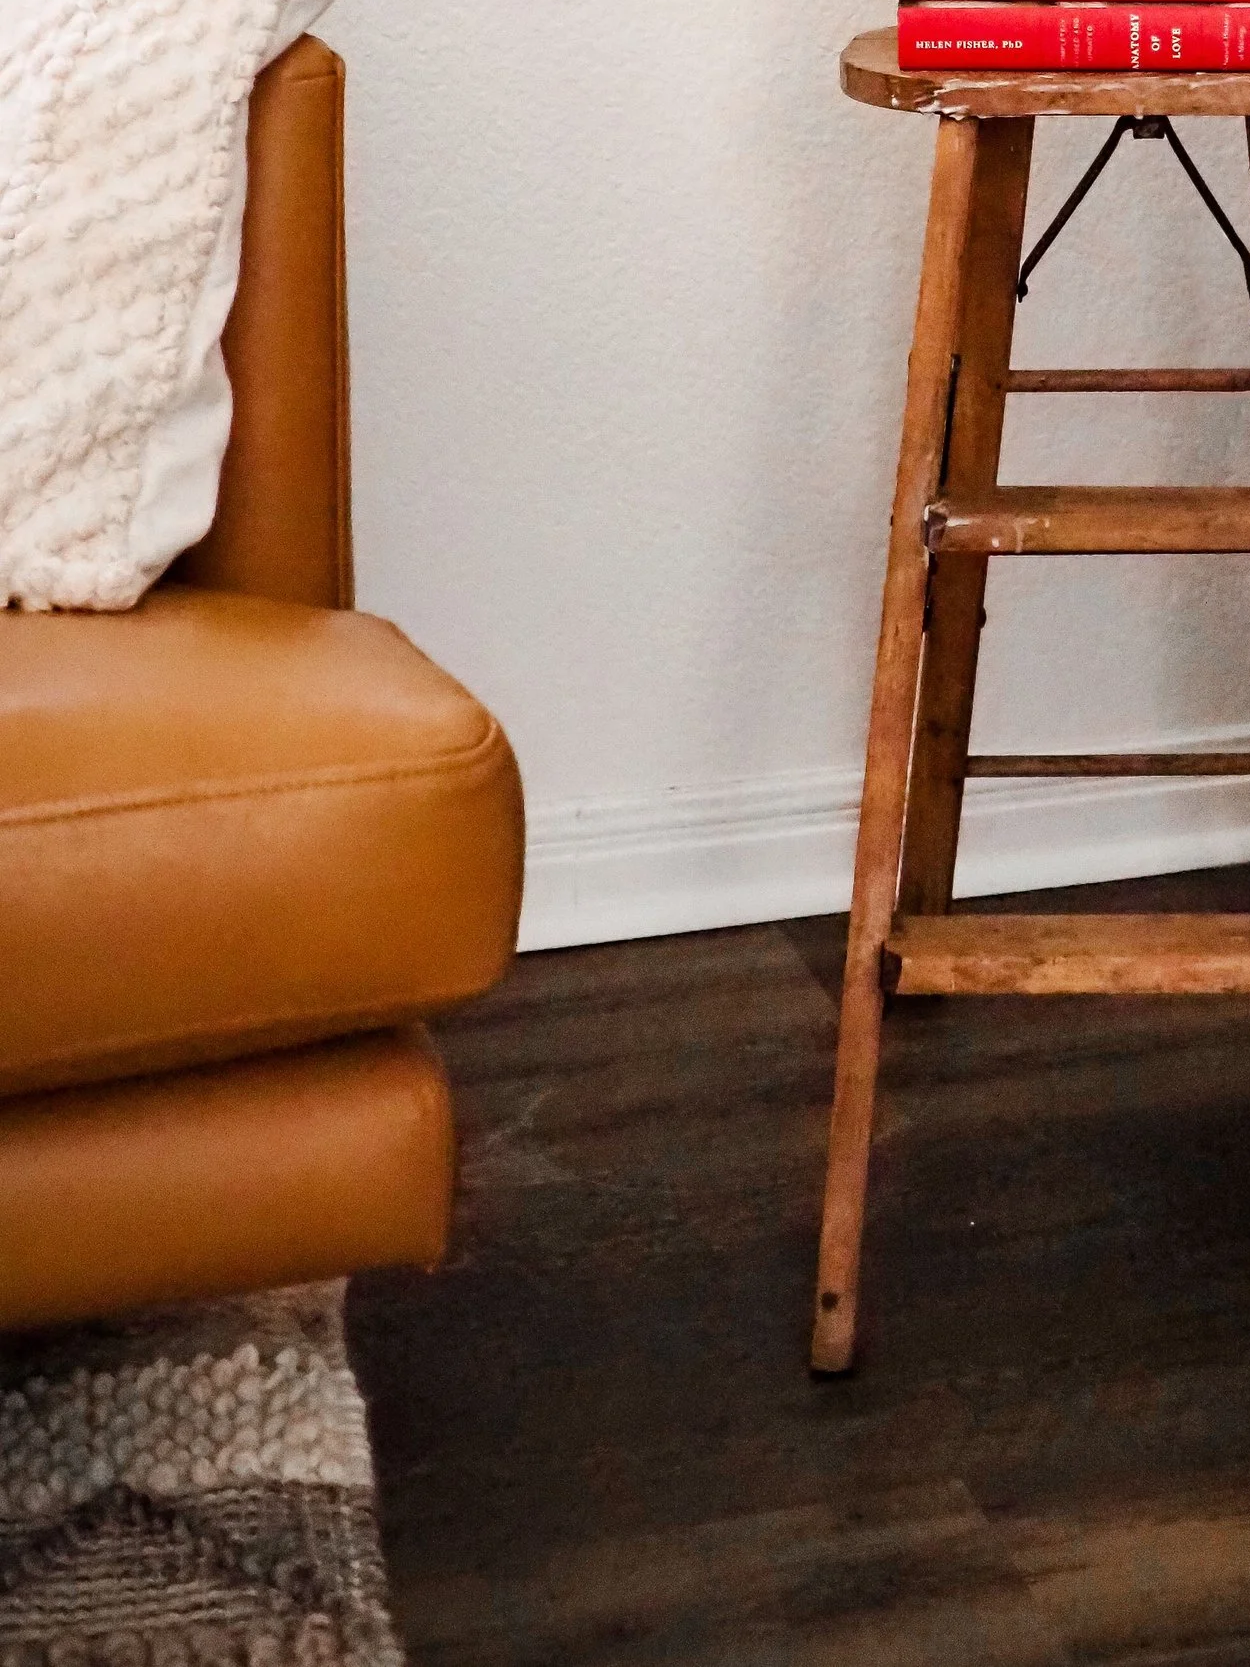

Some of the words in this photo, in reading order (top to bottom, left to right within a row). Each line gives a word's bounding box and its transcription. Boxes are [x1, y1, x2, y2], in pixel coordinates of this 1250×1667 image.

[915, 40, 952, 49] HELEN
[956, 40, 999, 50] FISHER,
[1002, 40, 1023, 49] PhD
[1130, 14, 1140, 70] ANATOMY
[1151, 35, 1160, 52] OF
[1171, 28, 1181, 59] LOVE
